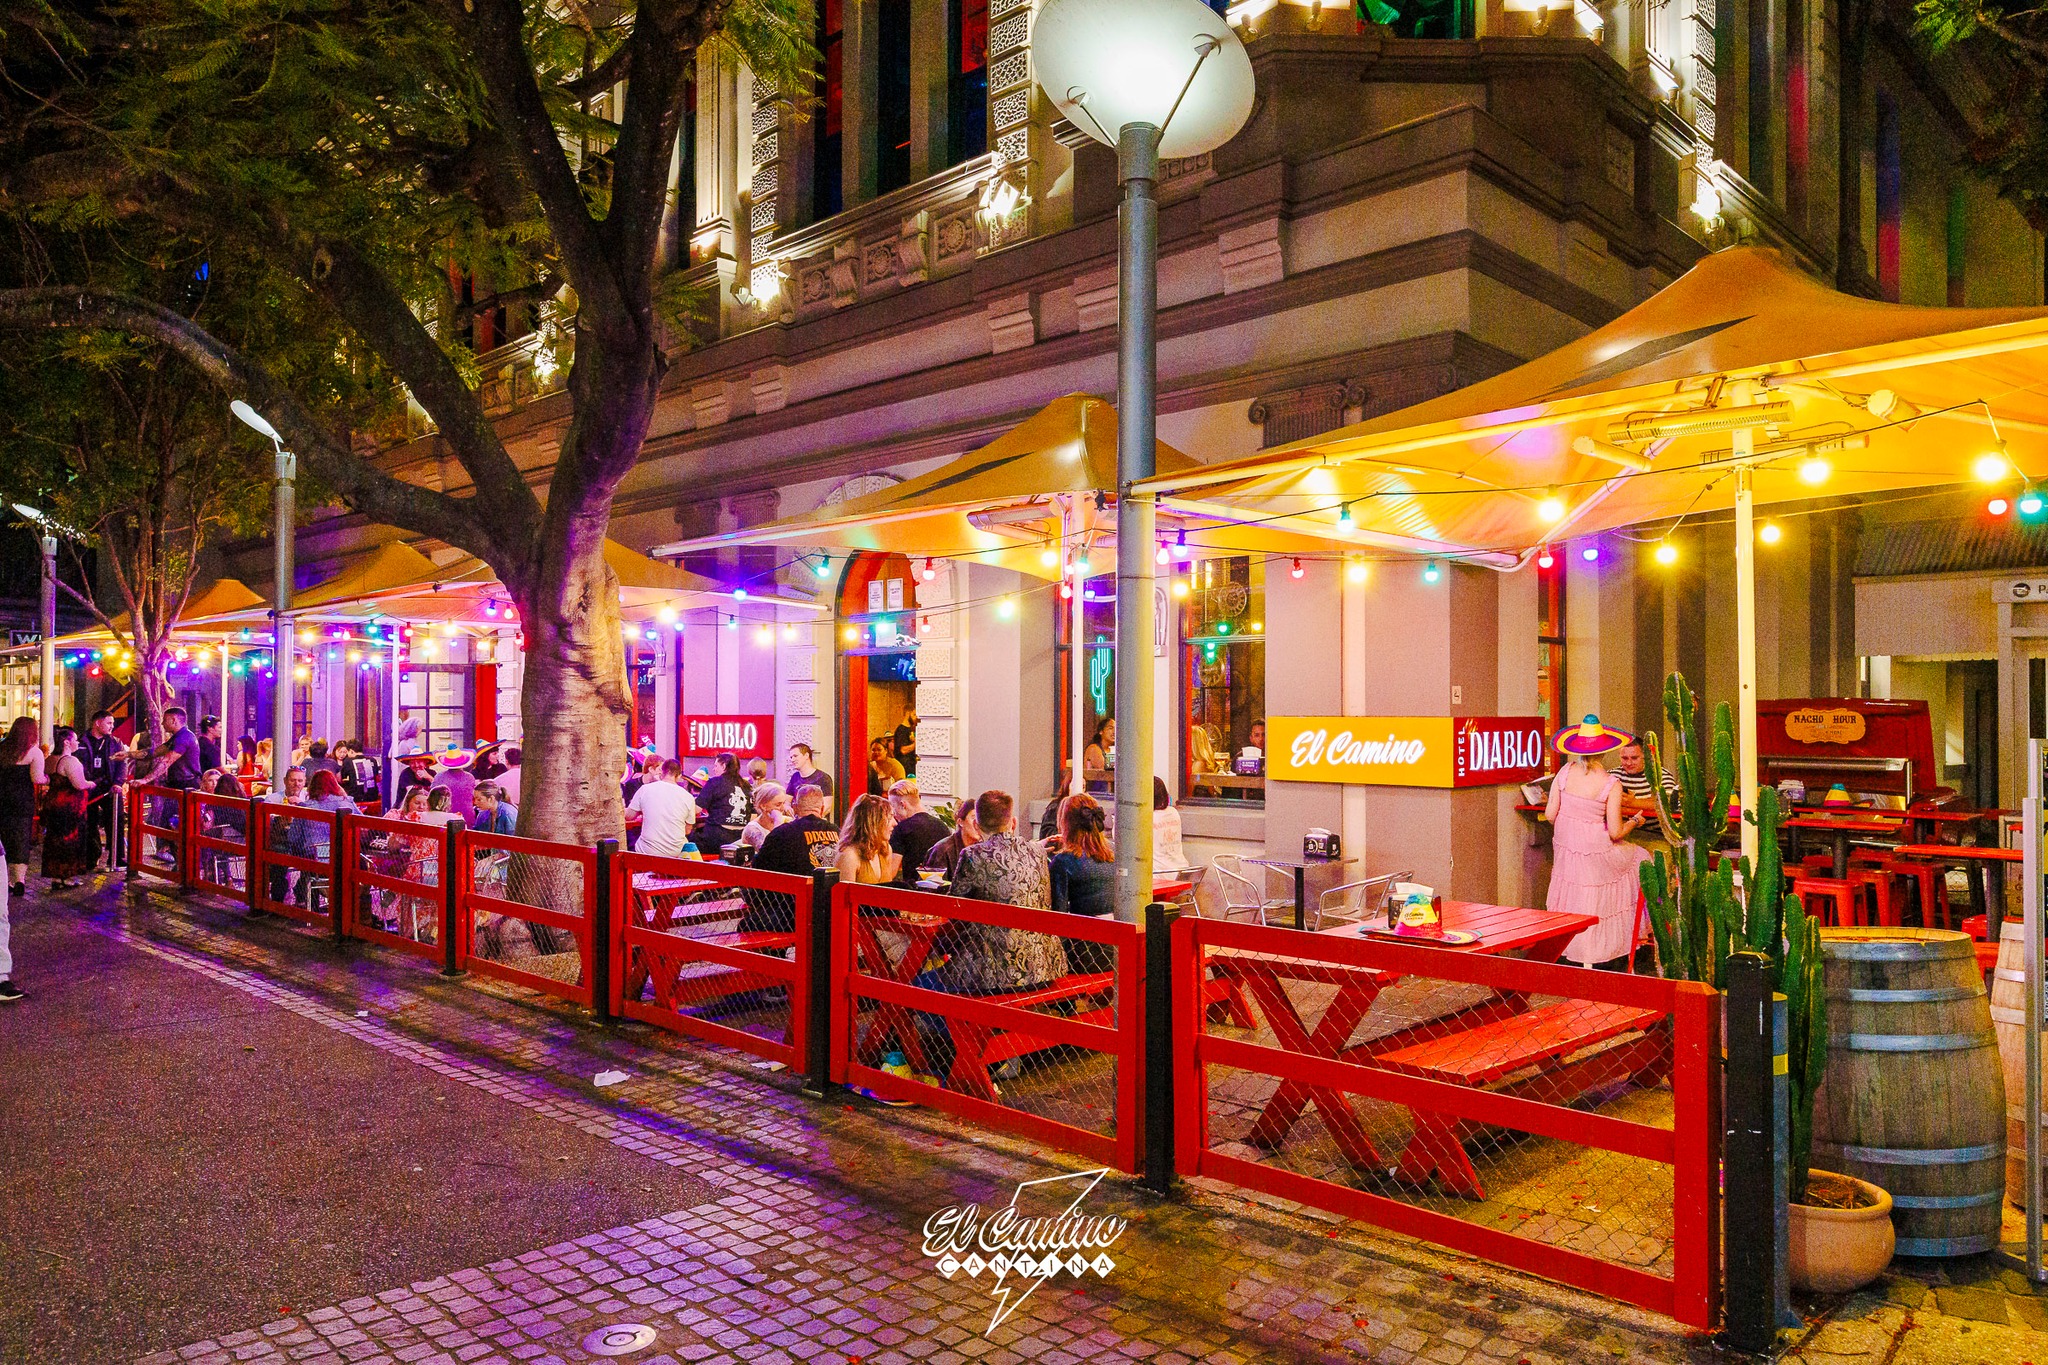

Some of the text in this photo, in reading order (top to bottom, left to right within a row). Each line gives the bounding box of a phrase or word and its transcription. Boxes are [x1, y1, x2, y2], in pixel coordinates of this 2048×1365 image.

[698, 722, 757, 750] DIABLO
[1794, 715, 1857, 724] NACHO HOUR
[1290, 729, 1425, 767] El Camino
[1458, 727, 1542, 777] HOTEL DIABLO
